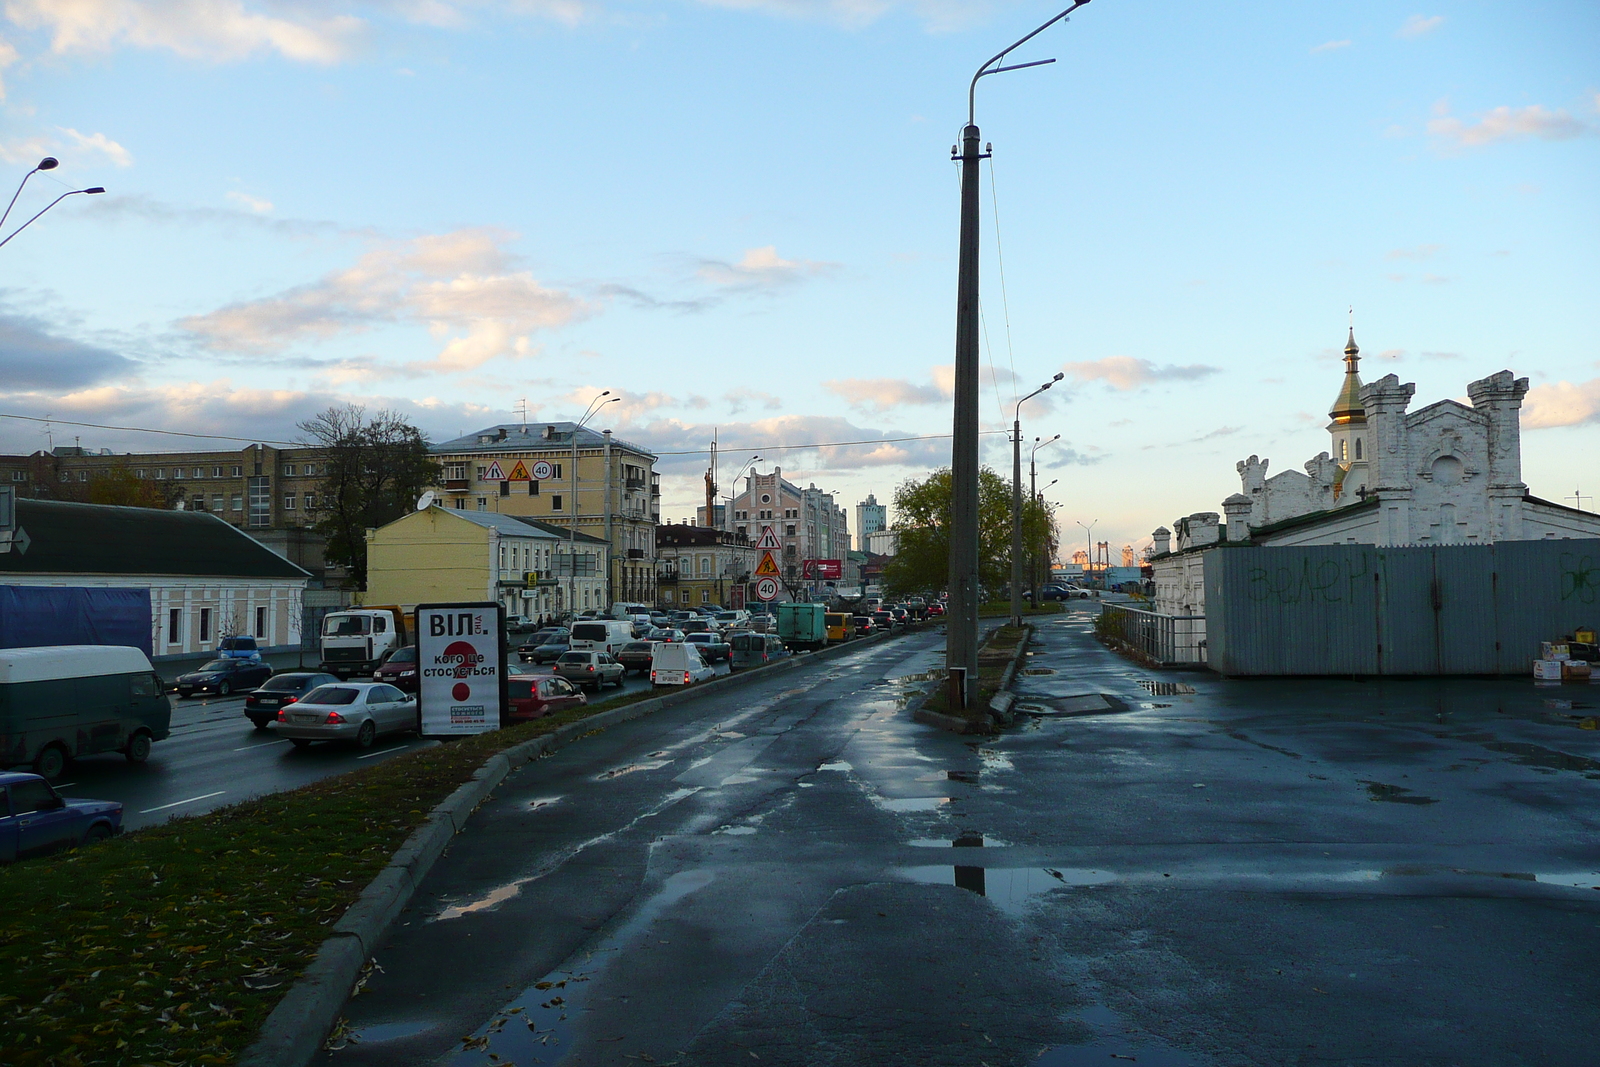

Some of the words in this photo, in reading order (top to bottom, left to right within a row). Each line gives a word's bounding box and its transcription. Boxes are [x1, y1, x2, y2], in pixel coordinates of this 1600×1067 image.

[535, 467, 547, 475] 40
[761, 584, 774, 594] 40
[434, 654, 464, 664] кого
[468, 654, 484, 664] це
[423, 666, 496, 679] стосується
